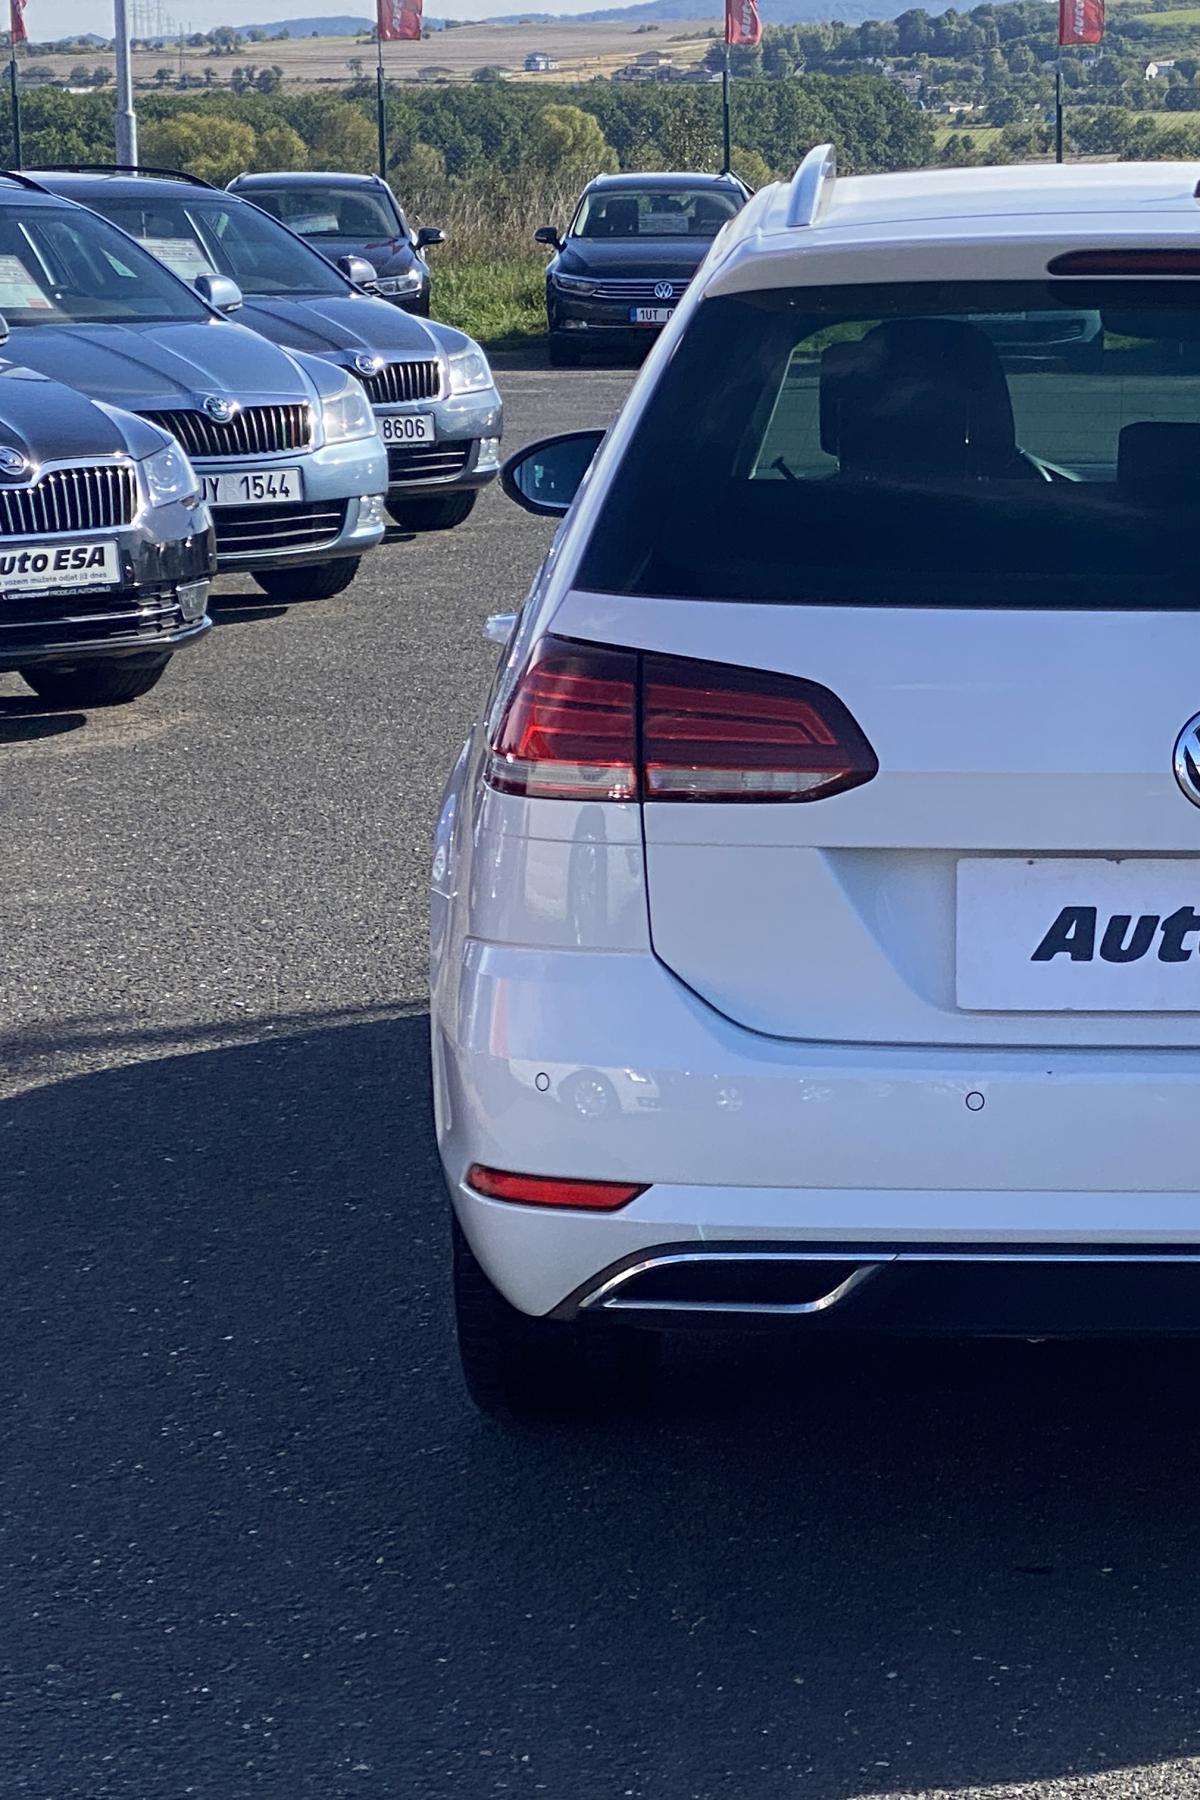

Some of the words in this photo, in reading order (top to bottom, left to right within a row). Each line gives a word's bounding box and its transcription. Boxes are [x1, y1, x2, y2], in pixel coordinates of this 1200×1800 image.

[640, 310, 658, 320] 1UT
[383, 418, 425, 439] 8606
[240, 474, 291, 500] 1544
[53, 546, 104, 571] ESA
